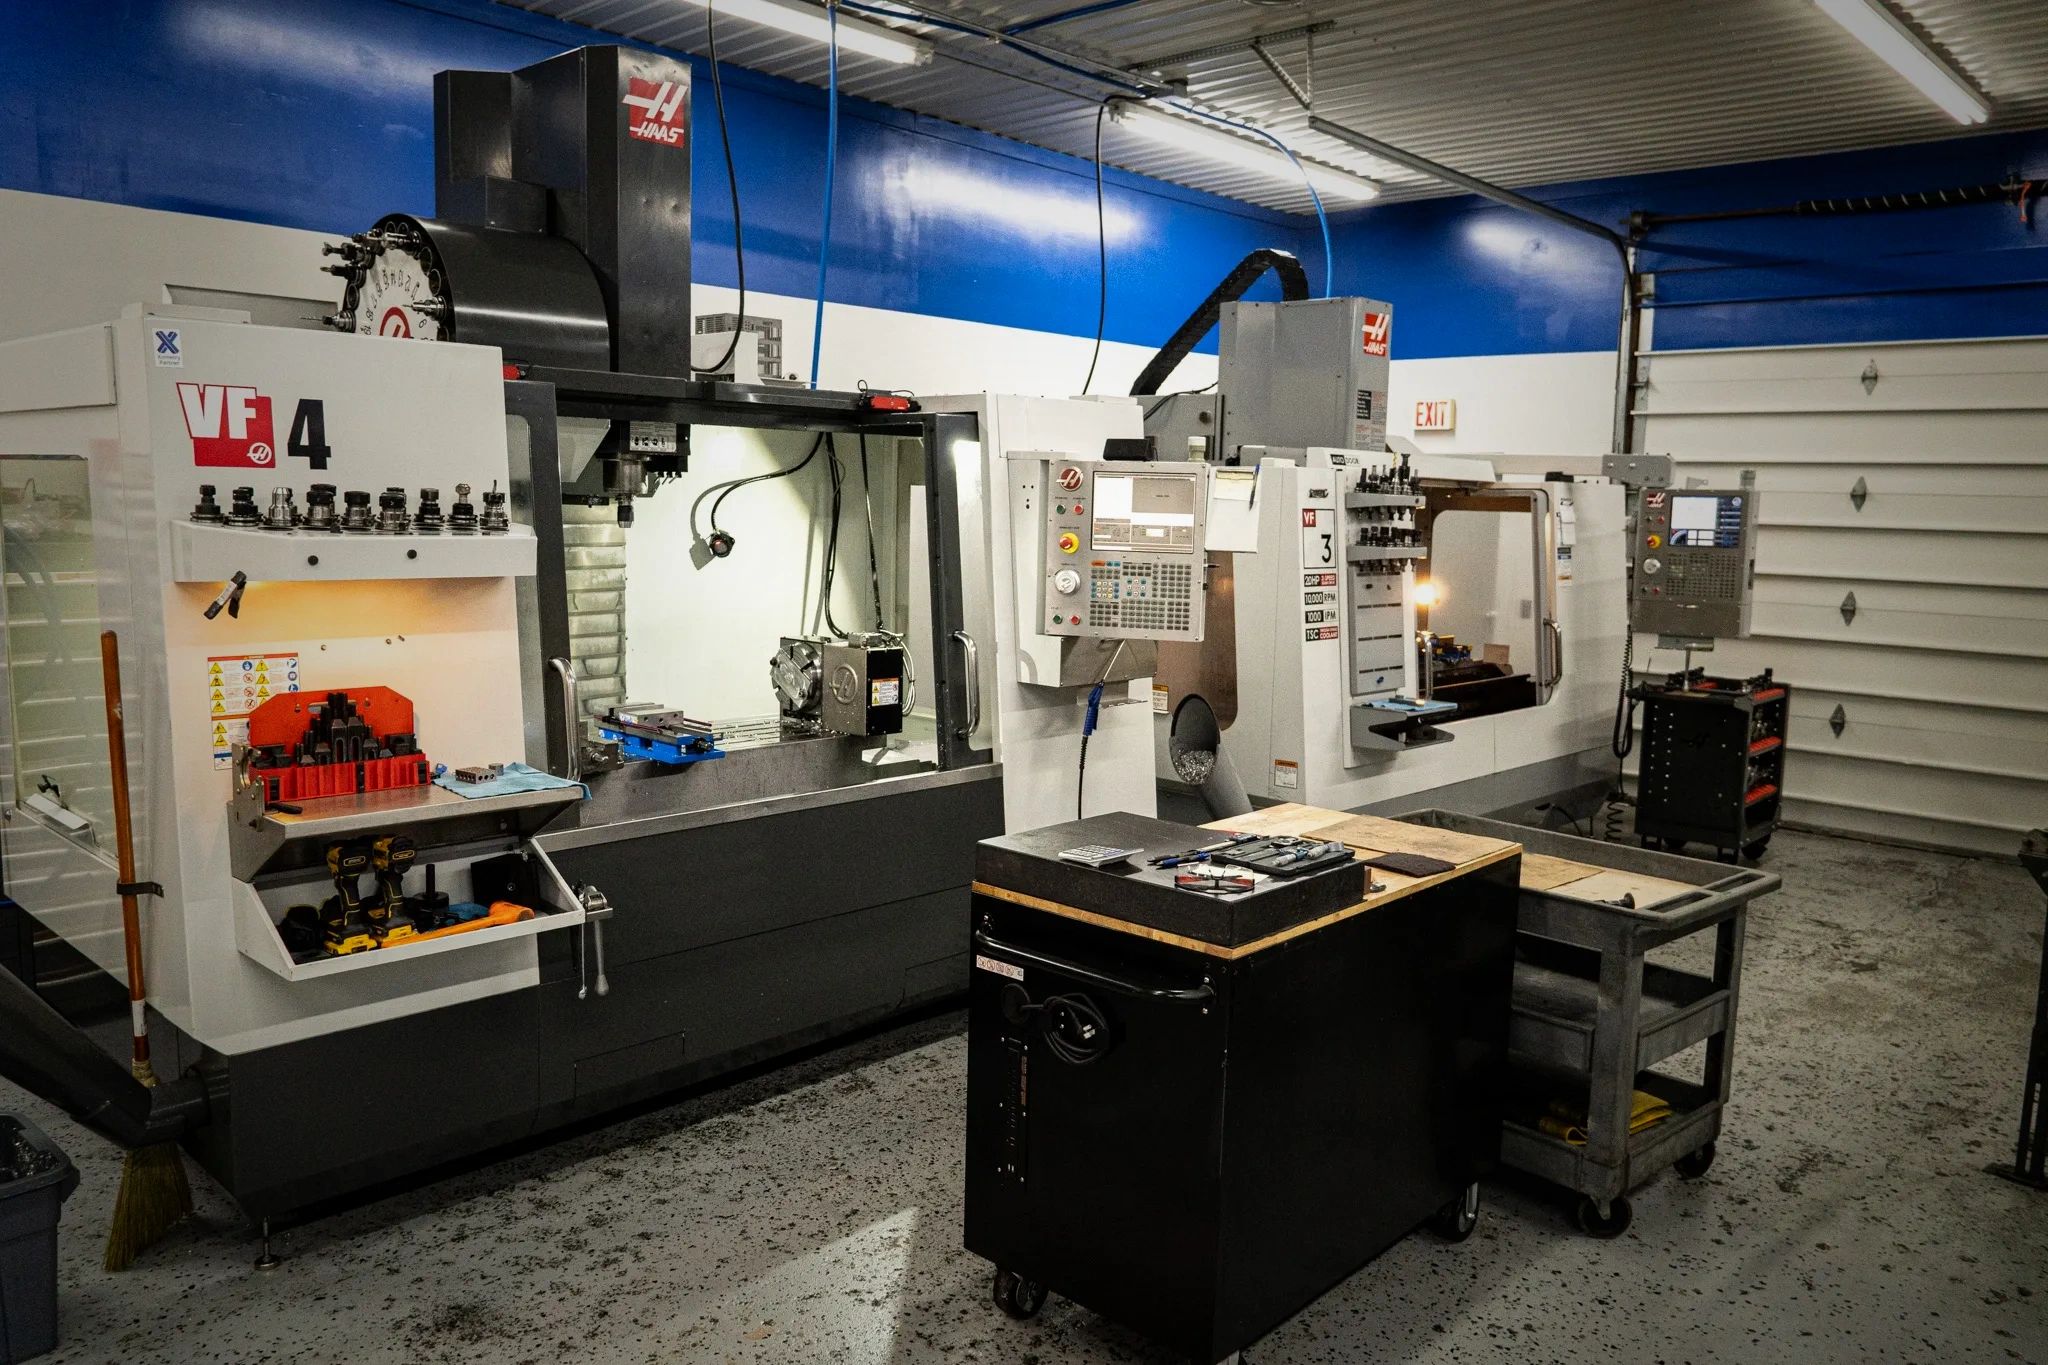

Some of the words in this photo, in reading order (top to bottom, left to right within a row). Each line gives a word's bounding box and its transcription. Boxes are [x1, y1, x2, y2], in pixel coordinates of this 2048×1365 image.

[629, 121, 684, 143] HAAS
[1415, 401, 1448, 427] EXIT
[176, 382, 258, 440] VF
[288, 398, 332, 470] 4
[1303, 511, 1315, 525] VF
[1320, 533, 1332, 563] 3
[1323, 592, 1337, 602] RPM
[1307, 611, 1322, 622] 1000
[1306, 629, 1319, 640] TSC
